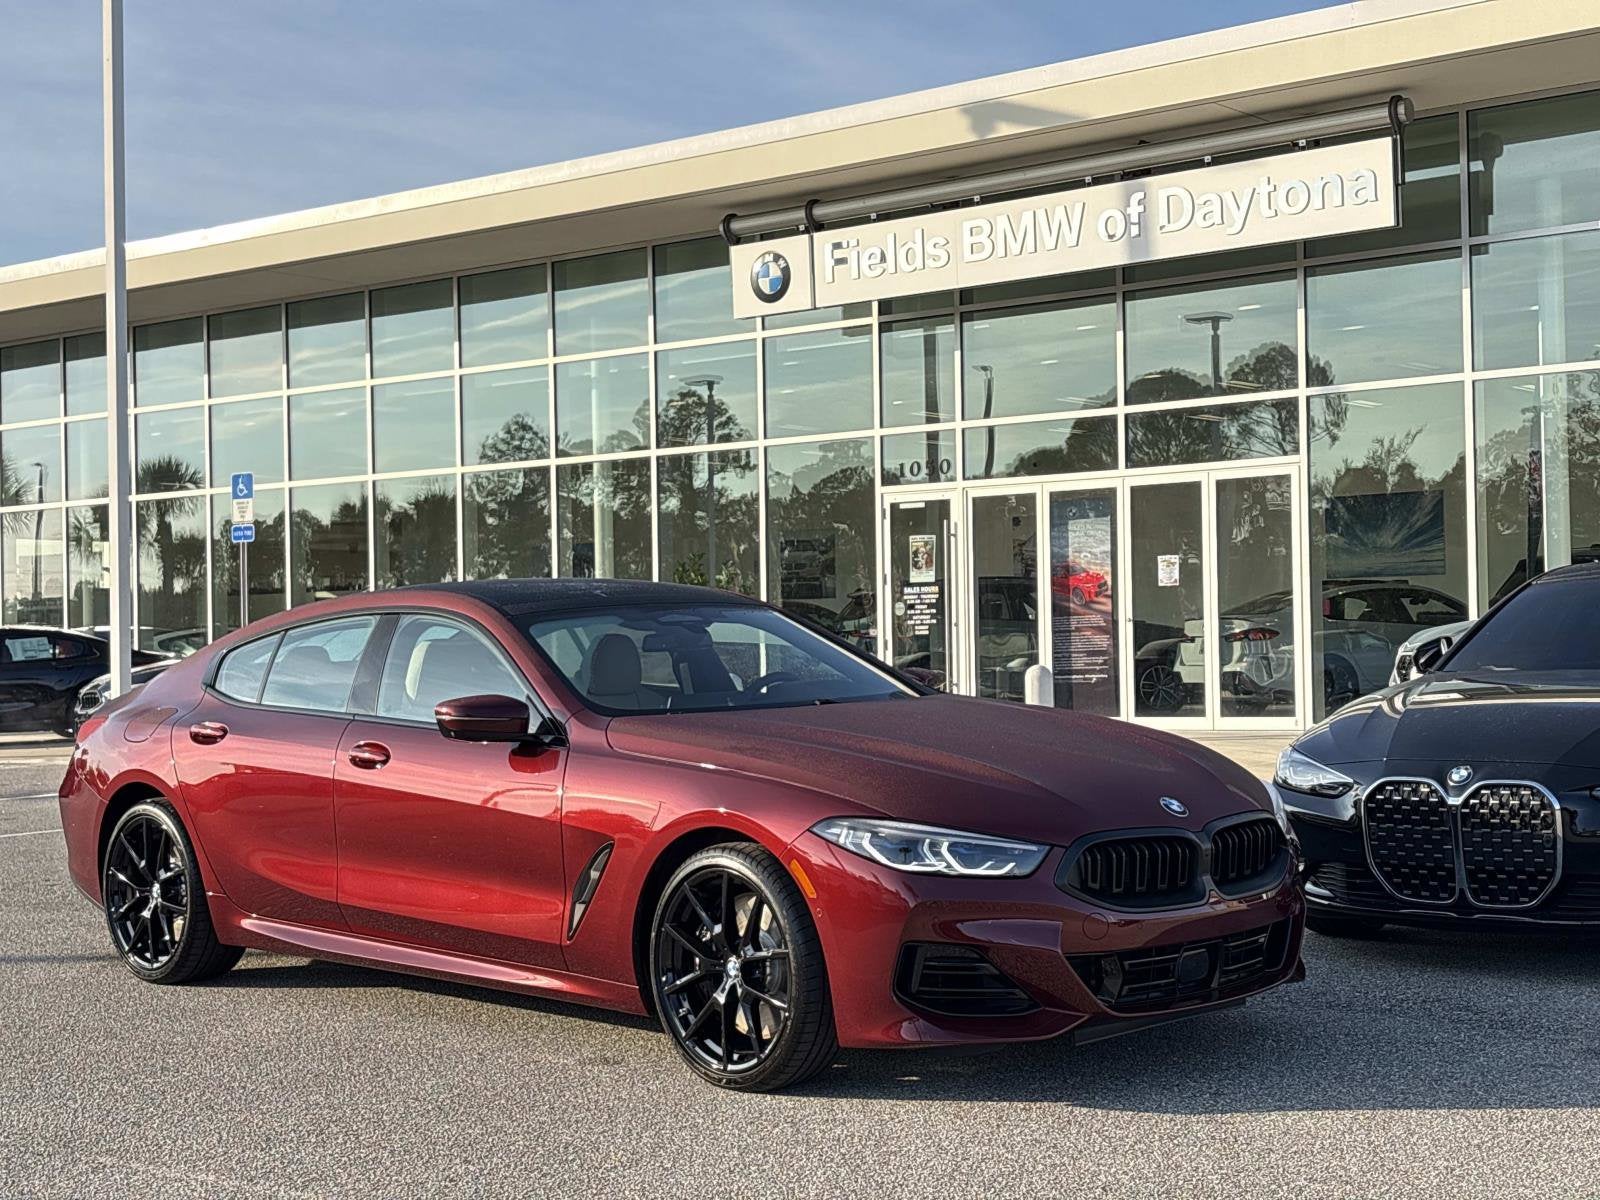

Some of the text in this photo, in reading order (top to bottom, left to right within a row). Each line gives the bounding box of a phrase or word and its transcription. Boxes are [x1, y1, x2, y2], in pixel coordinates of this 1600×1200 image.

[823, 167, 1379, 284] Fields BMW of Daytona
